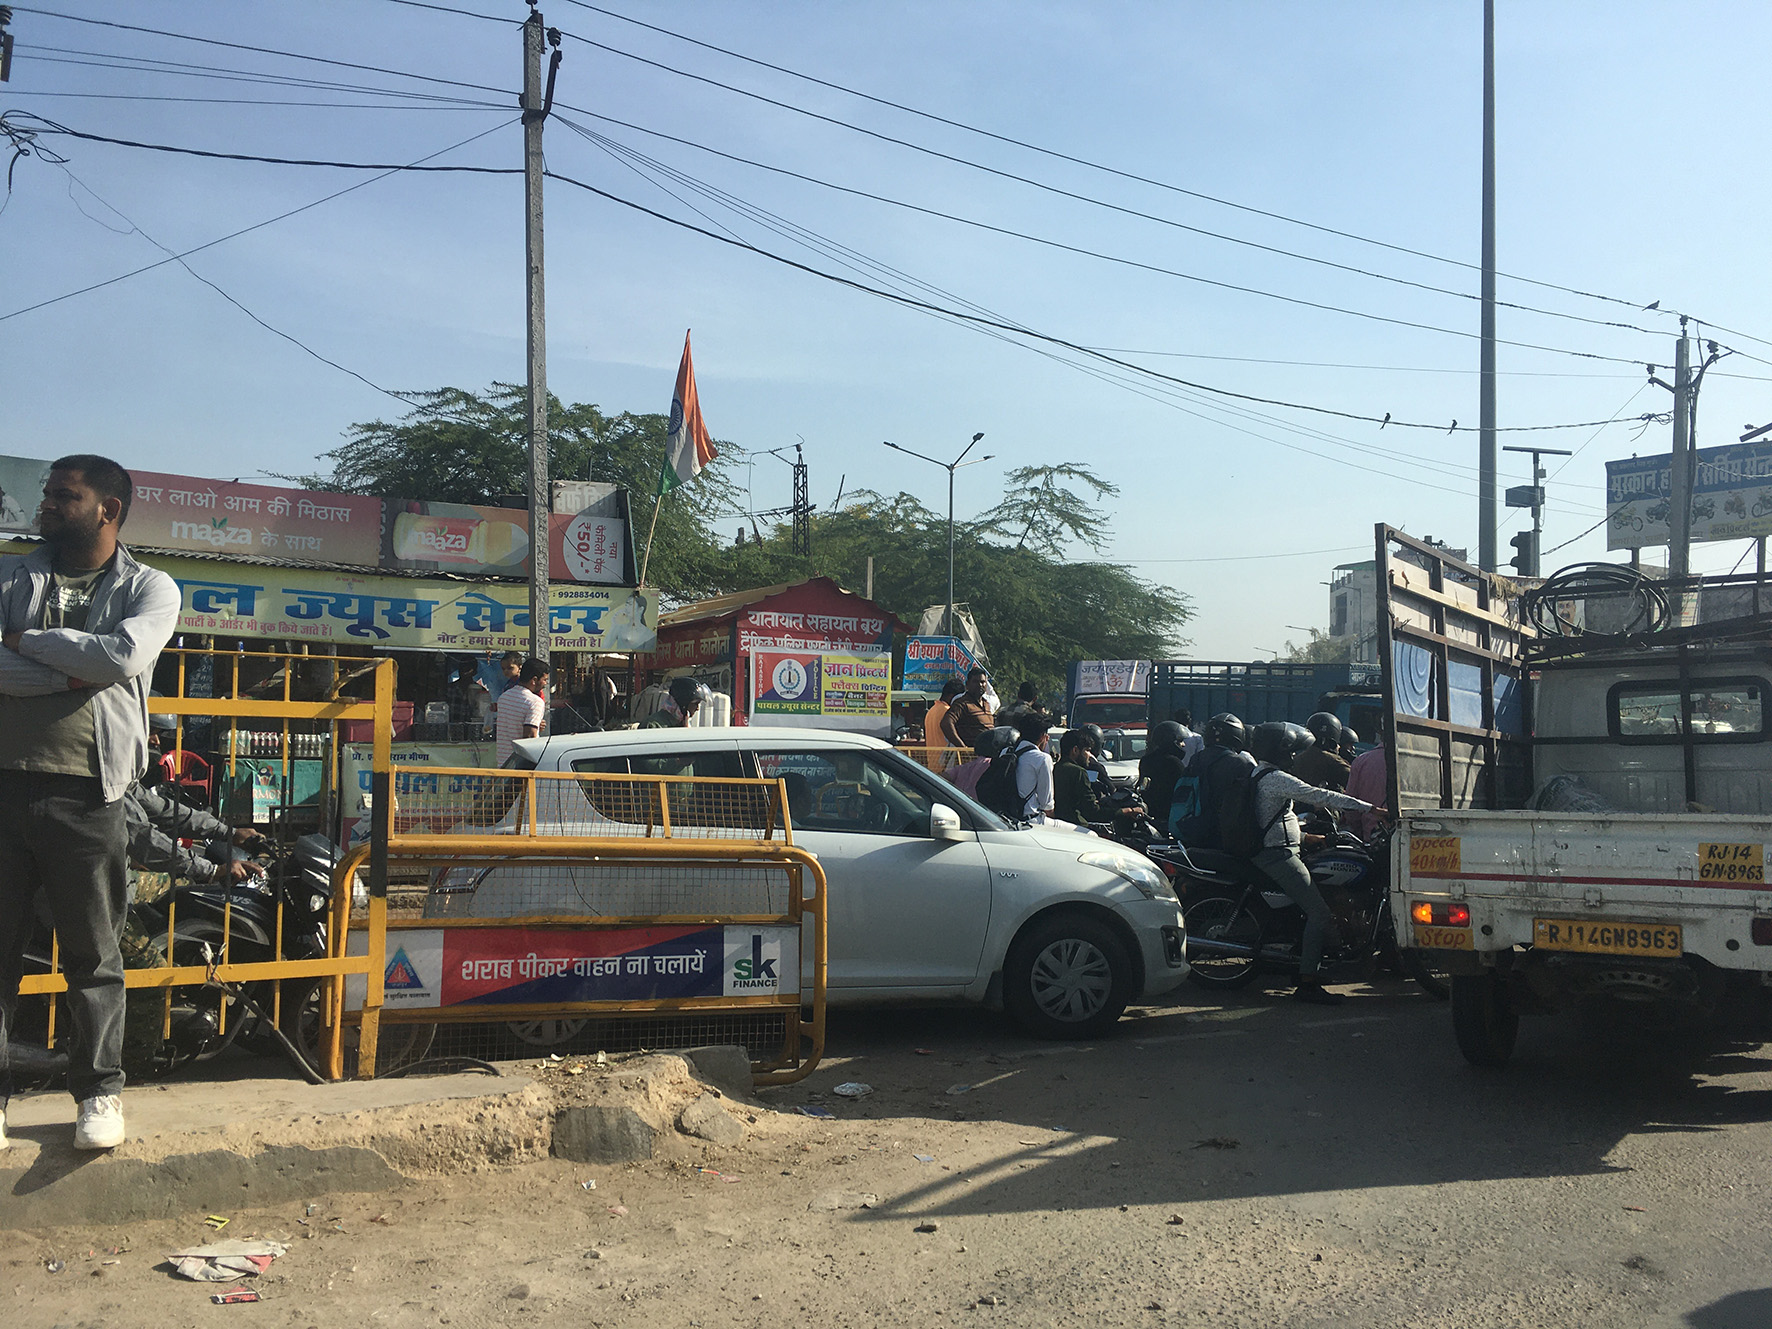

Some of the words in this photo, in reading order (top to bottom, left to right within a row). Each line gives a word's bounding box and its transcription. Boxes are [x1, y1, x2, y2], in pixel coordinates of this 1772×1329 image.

[136, 485, 163, 503] घर
[168, 487, 218, 509] लाओ
[223, 495, 262, 513] आम
[267, 496, 292, 517] की
[297, 499, 351, 522] मिठास
[171, 520, 252, 546] maaza
[260, 527, 279, 547] के
[285, 535, 323, 552] साथ
[408, 528, 467, 550] maaza
[609, 542, 618, 559] नया
[558, 591, 609, 600] 9928834014
[281, 588, 439, 639] ज्यूस
[747, 610, 804, 630] यातायात
[806, 614, 858, 633] सहायता
[860, 618, 883, 635] बूथ
[184, 615, 204, 628] पार्टी
[207, 616, 216, 627] के
[247, 619, 257, 631] भी
[260, 622, 276, 635] बुक
[278, 622, 298, 634] किये
[300, 623, 319, 636] जाते
[437, 634, 457, 646] नोट
[468, 633, 493, 646] हमारे
[555, 636, 586, 647] मिलती
[757, 702, 780, 710] पायल
[781, 702, 799, 711] ज्यूस
[408, 752, 429, 761] मीणा
[1421, 928, 1465, 948] Stop
[1549, 924, 1679, 950] RJ14GN8963
[461, 958, 514, 981] शराब
[518, 952, 569, 979] पीकर
[573, 954, 620, 977] वाहन
[624, 956, 651, 975] ना
[654, 949, 707, 976] चलायें
[732, 979, 778, 988] FINANCE
